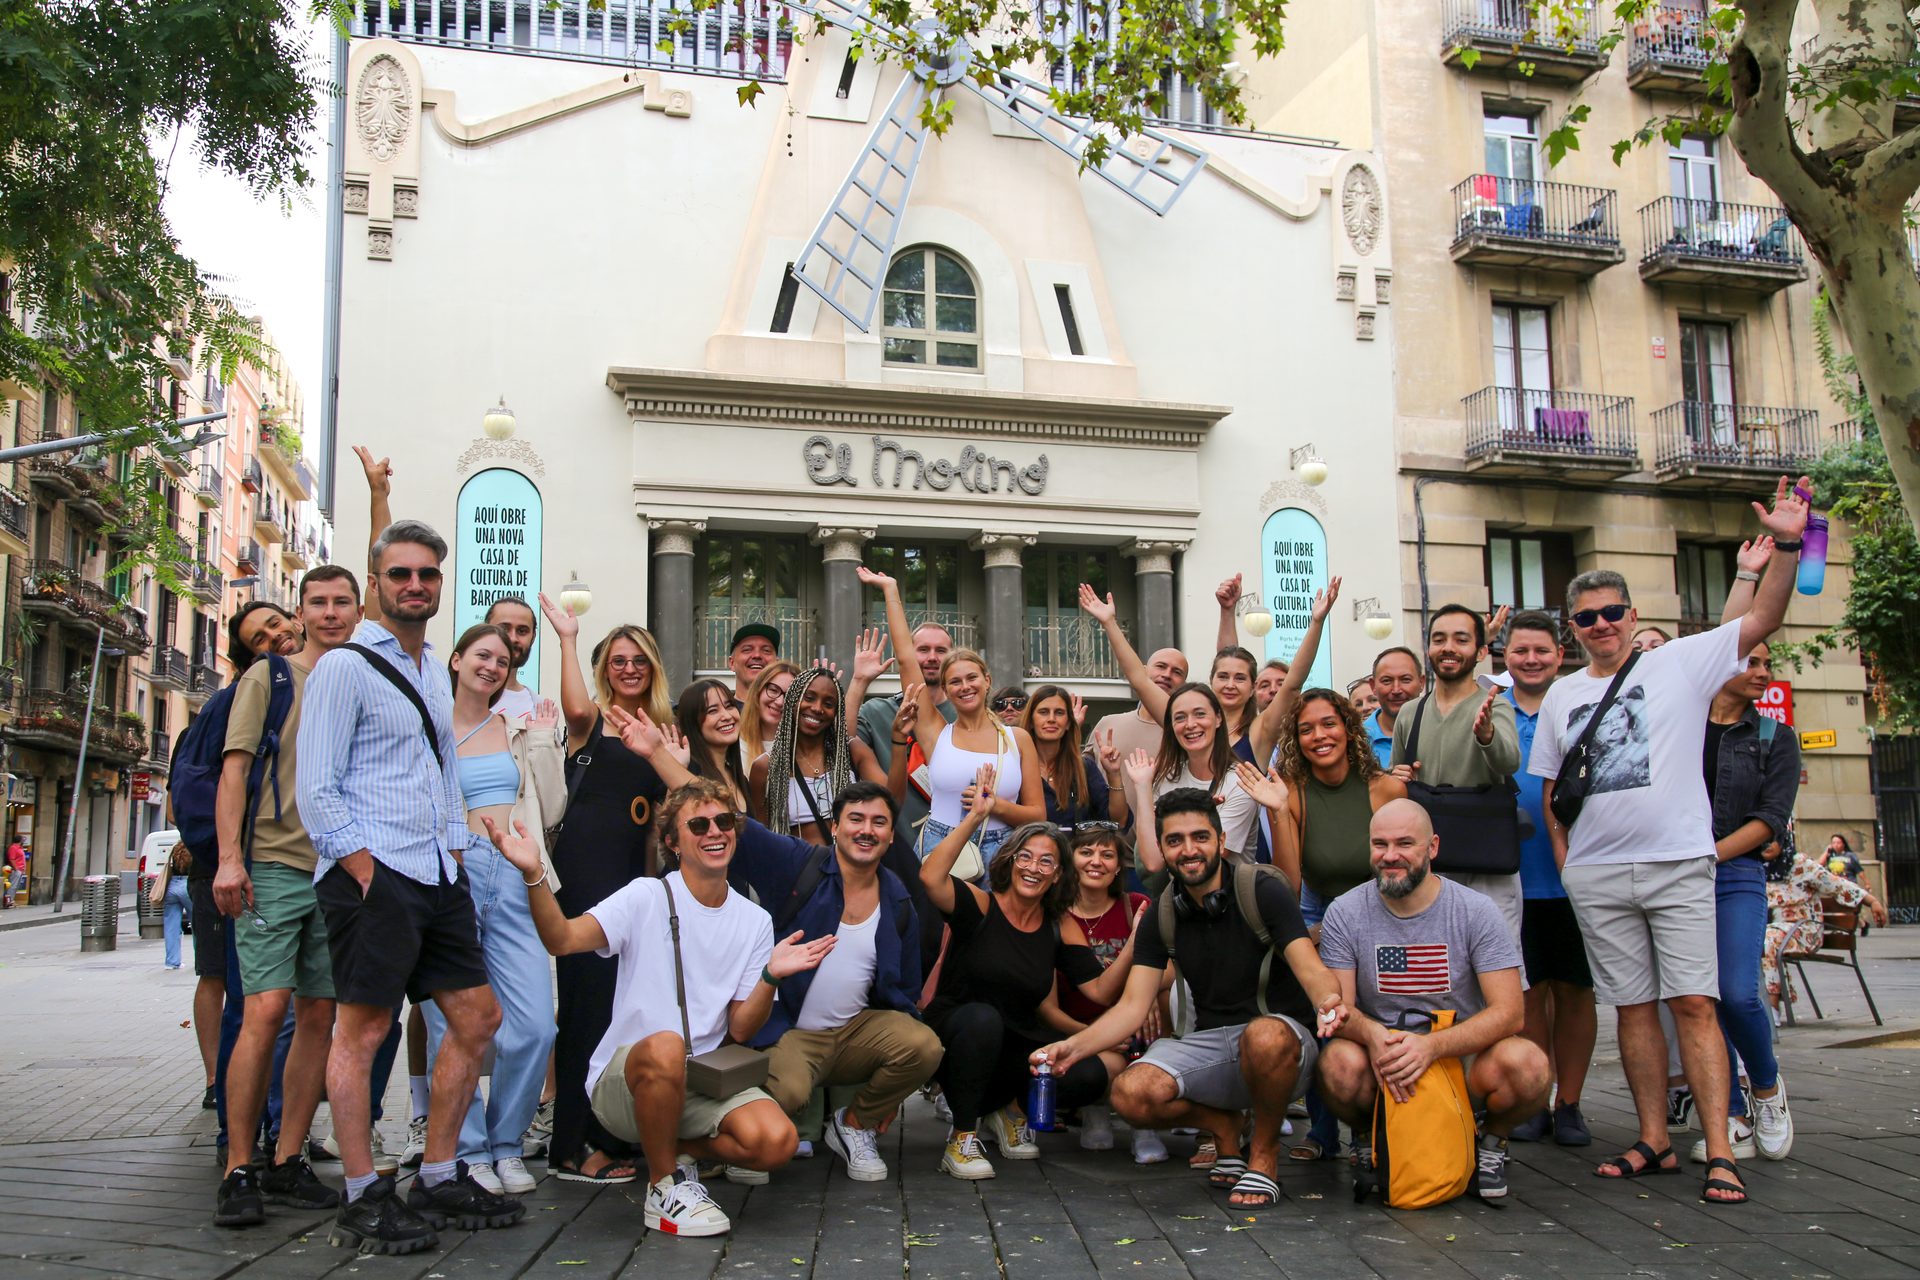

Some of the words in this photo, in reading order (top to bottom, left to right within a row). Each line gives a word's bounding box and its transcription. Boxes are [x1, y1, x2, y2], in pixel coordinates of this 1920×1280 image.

[803, 435, 858, 487] El
[872, 435, 1050, 495] Molino
[474, 504, 498, 525] AQUÍ
[501, 507, 526, 525] OBRE
[475, 527, 496, 545] UNA
[499, 528, 524, 545] NOVA
[480, 548, 504, 565] CASA
[507, 549, 519, 566] DE
[1274, 539, 1292, 557] AQUÍ
[1294, 541, 1314, 557] OBRE
[1275, 559, 1291, 574] UNA
[1294, 560, 1314, 575] NOVA
[470, 568, 513, 586] CULTURA
[516, 570, 528, 587] DE
[1280, 577, 1300, 593] CASA
[1301, 578, 1310, 593] DE
[1274, 595, 1307, 611] CULTURA
[1275, 614, 1313, 629] BARCELON
